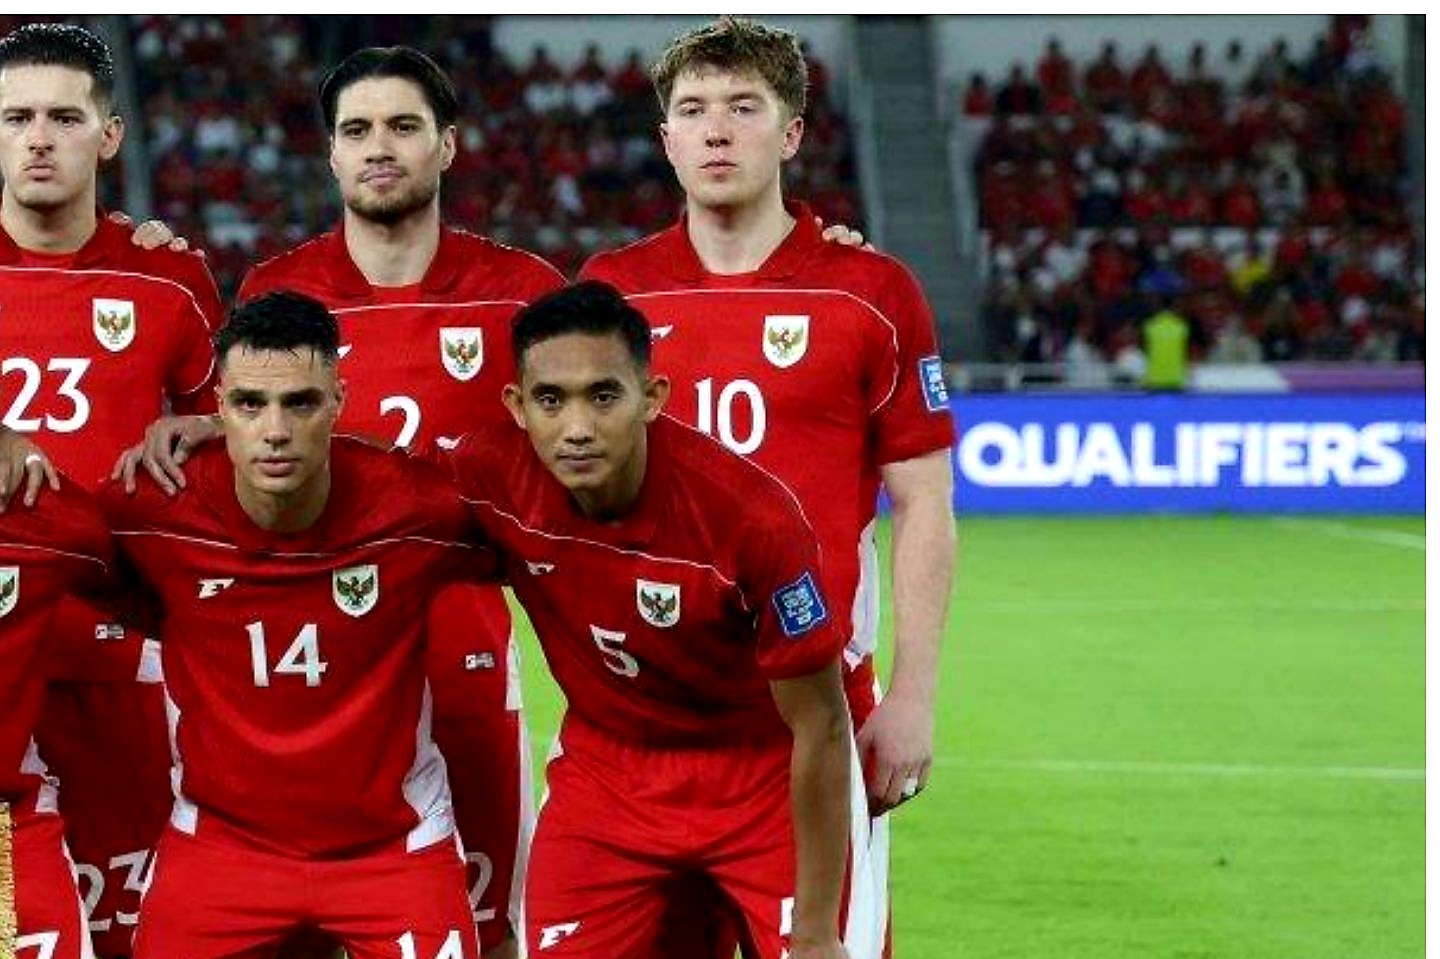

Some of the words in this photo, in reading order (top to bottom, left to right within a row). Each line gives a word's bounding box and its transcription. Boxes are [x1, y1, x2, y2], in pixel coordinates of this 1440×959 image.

[0, 358, 92, 433] 23
[379, 395, 422, 449] 2
[693, 377, 766, 455] 10
[959, 421, 1408, 488] QUALIFIERS
[244, 620, 329, 688] 14
[589, 623, 640, 678] 5
[75, 848, 151, 931] 23
